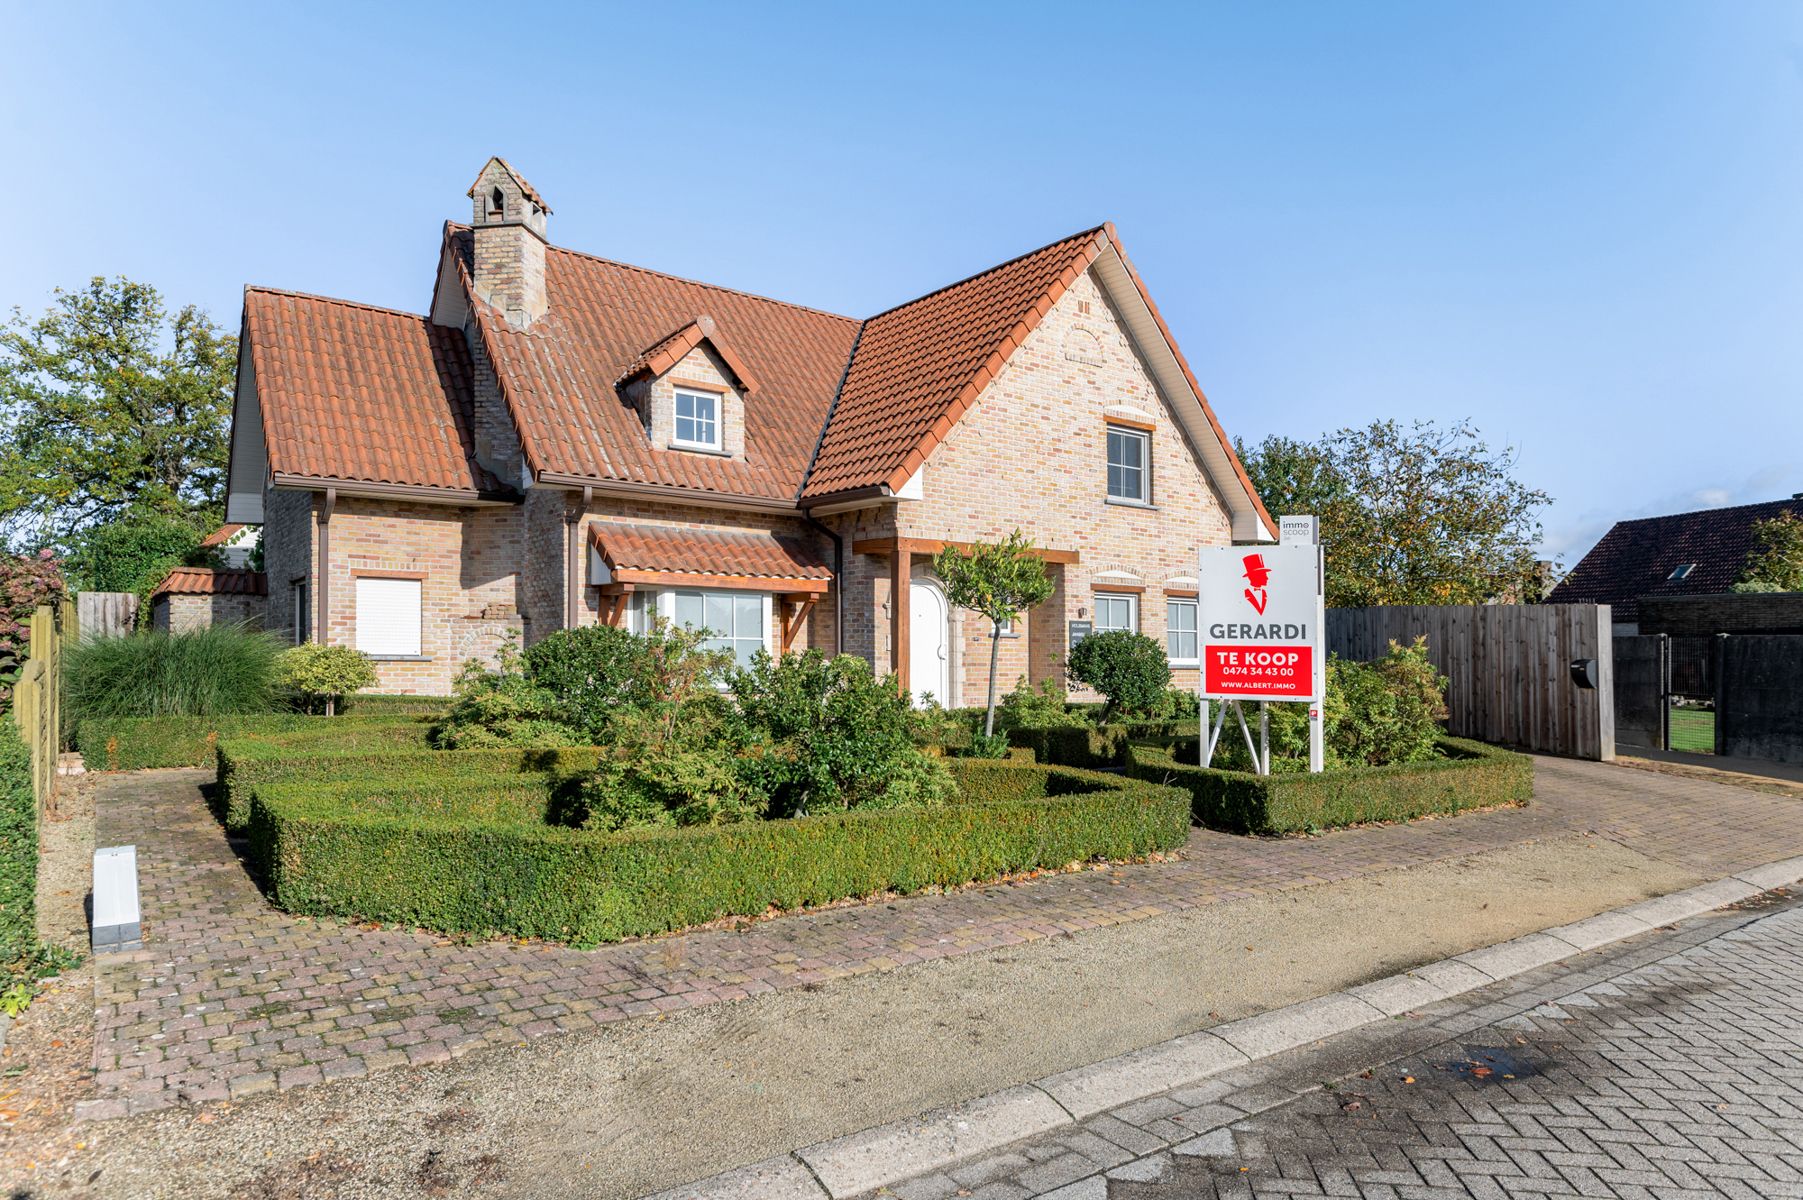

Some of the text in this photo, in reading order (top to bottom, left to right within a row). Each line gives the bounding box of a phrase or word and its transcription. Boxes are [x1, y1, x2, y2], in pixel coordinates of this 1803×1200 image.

[1283, 521, 1309, 529] immo
[1283, 529, 1309, 537] scoop
[1209, 624, 1306, 640] GERARDI
[1217, 652, 1299, 666] TE KOOP
[1223, 666, 1294, 676] 0474 34 43 00
[1221, 681, 1296, 690] WWW.ALBERT.IMMO
